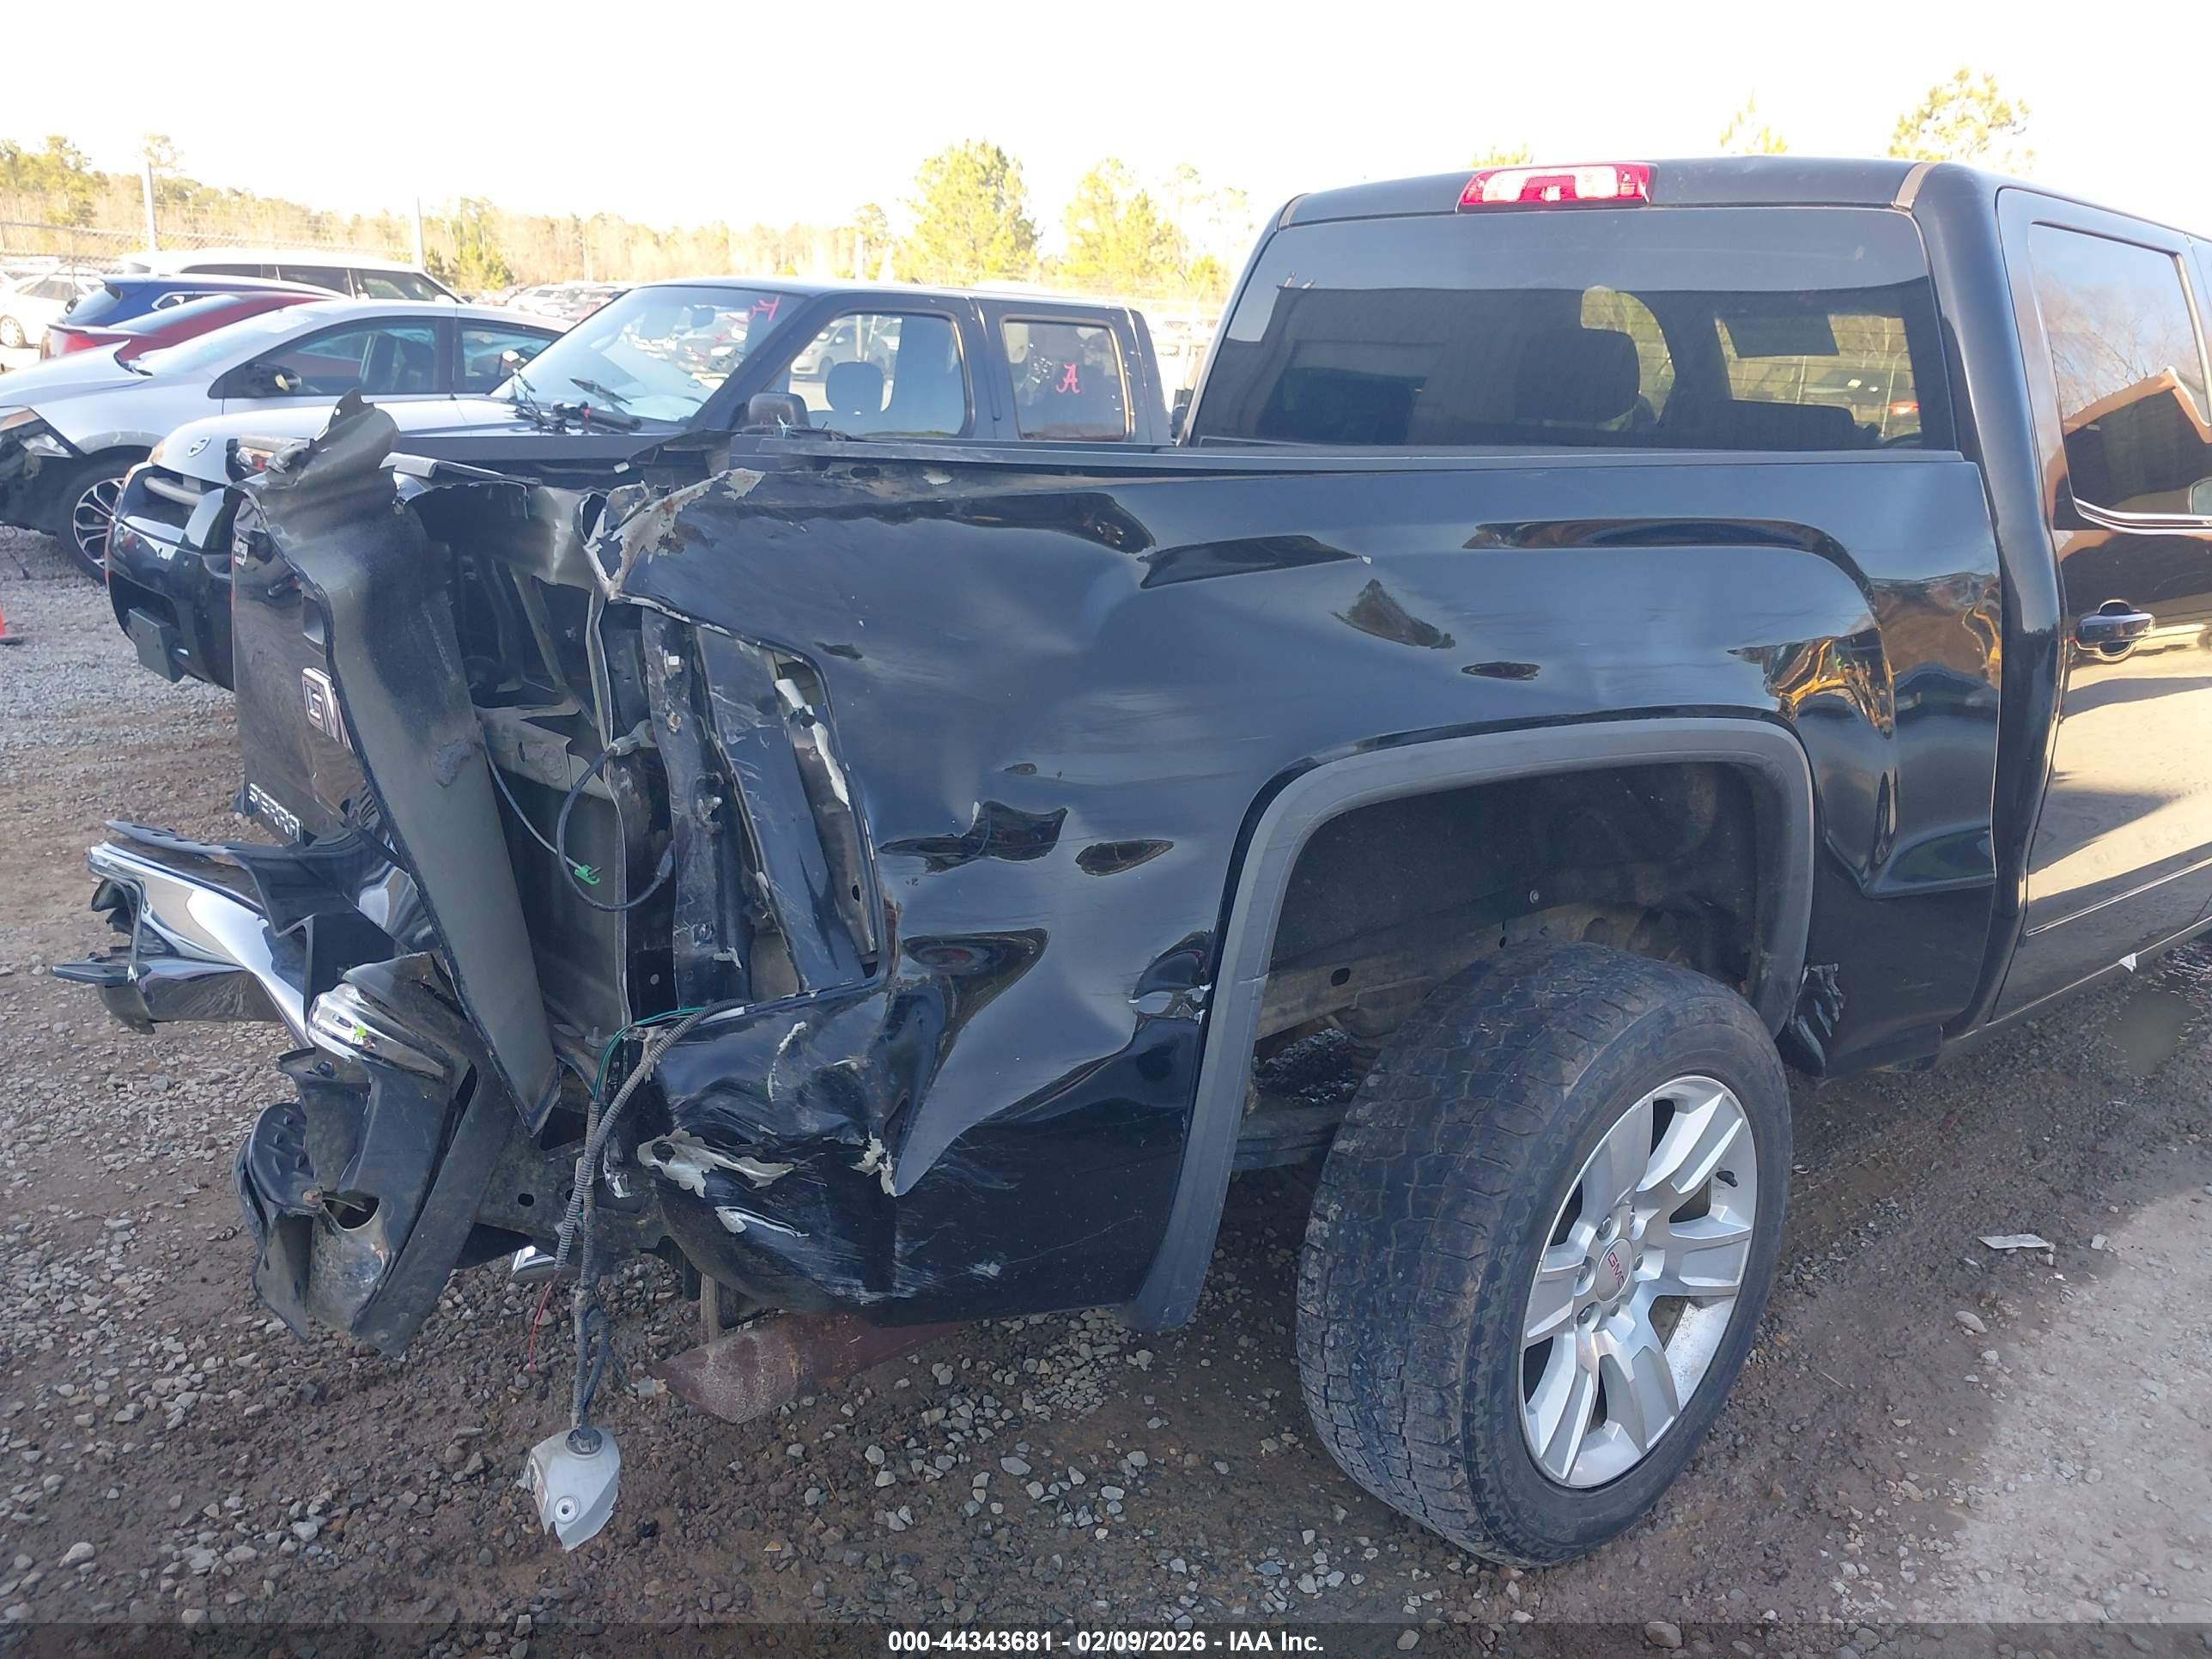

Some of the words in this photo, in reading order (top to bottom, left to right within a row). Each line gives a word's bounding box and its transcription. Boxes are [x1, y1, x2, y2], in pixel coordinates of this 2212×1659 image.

[1056, 362, 1080, 394] A
[301, 666, 356, 755] GM
[1607, 1250, 1626, 1290] GMC
